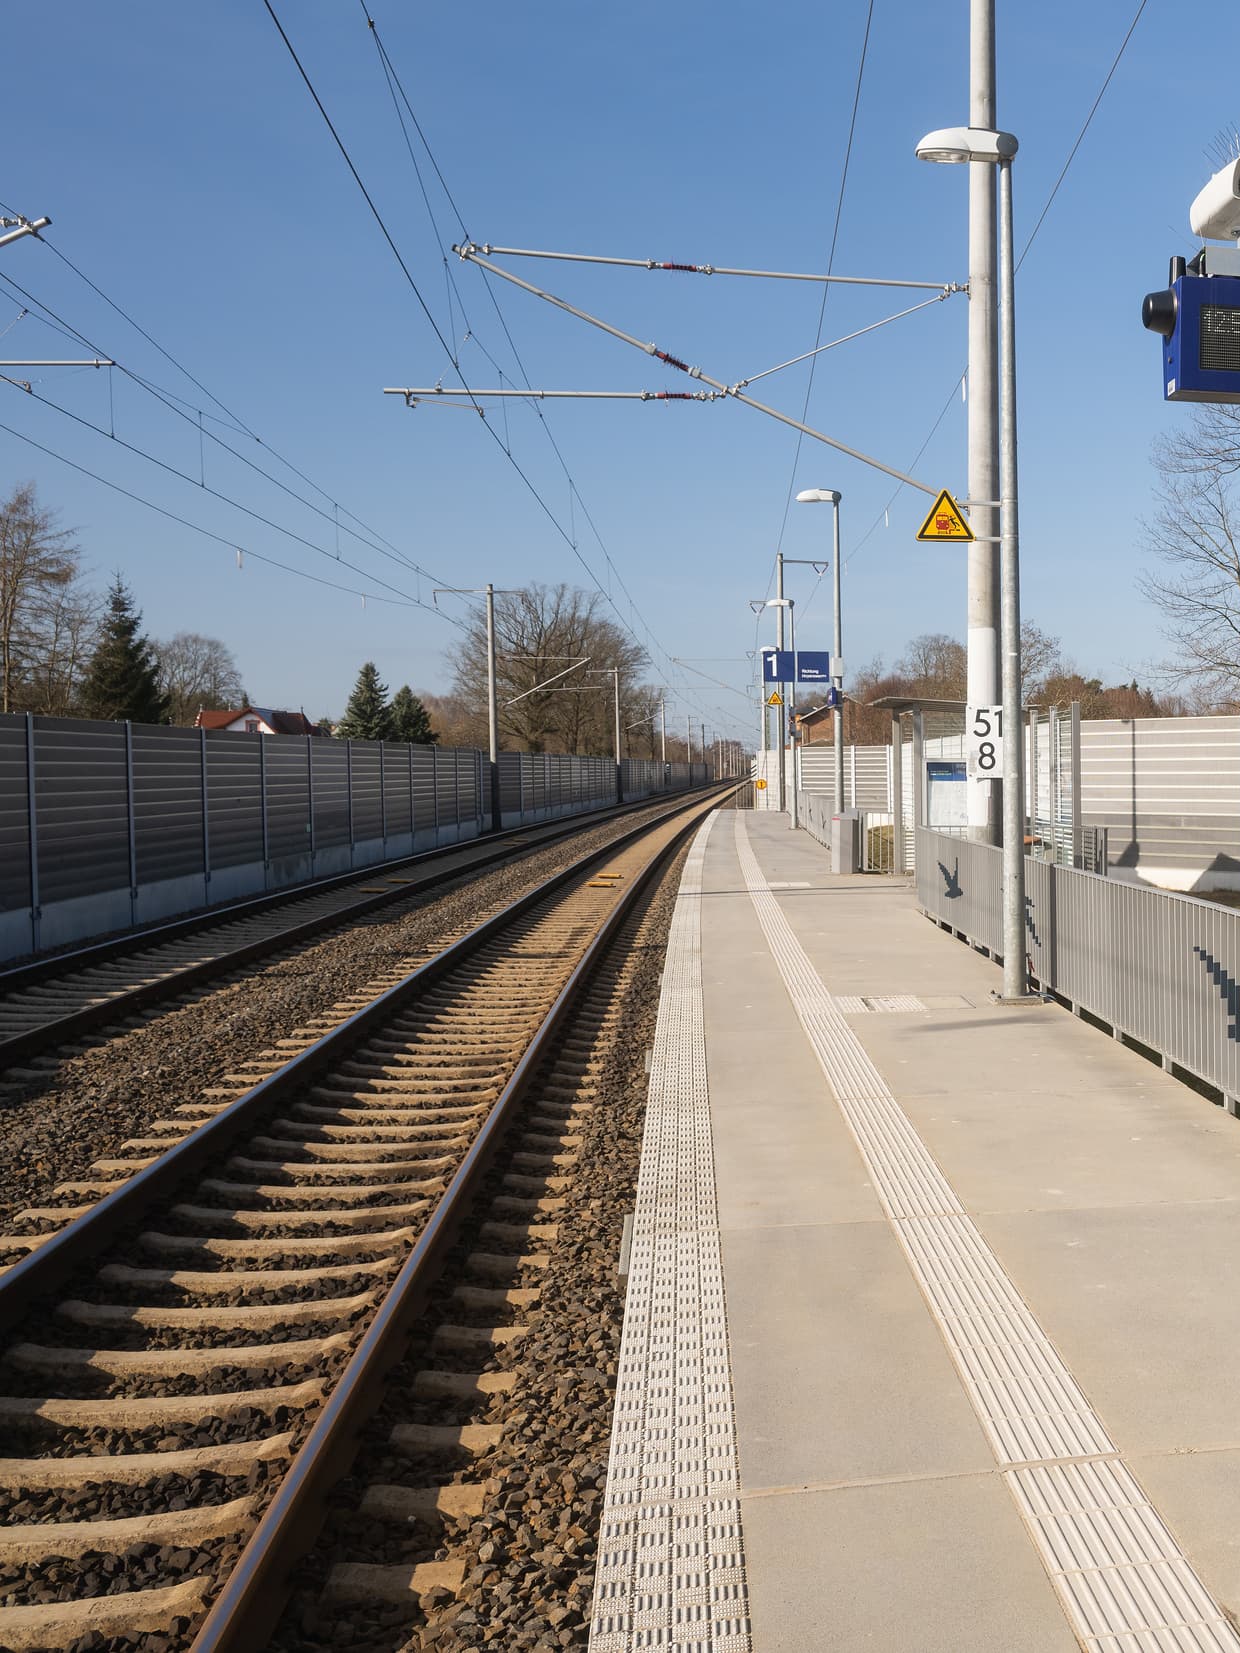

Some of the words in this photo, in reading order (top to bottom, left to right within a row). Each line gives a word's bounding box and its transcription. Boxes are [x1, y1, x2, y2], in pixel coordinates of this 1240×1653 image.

[766, 653, 777, 677] 1
[973, 709, 1003, 737] 51
[978, 742, 996, 770] 8
